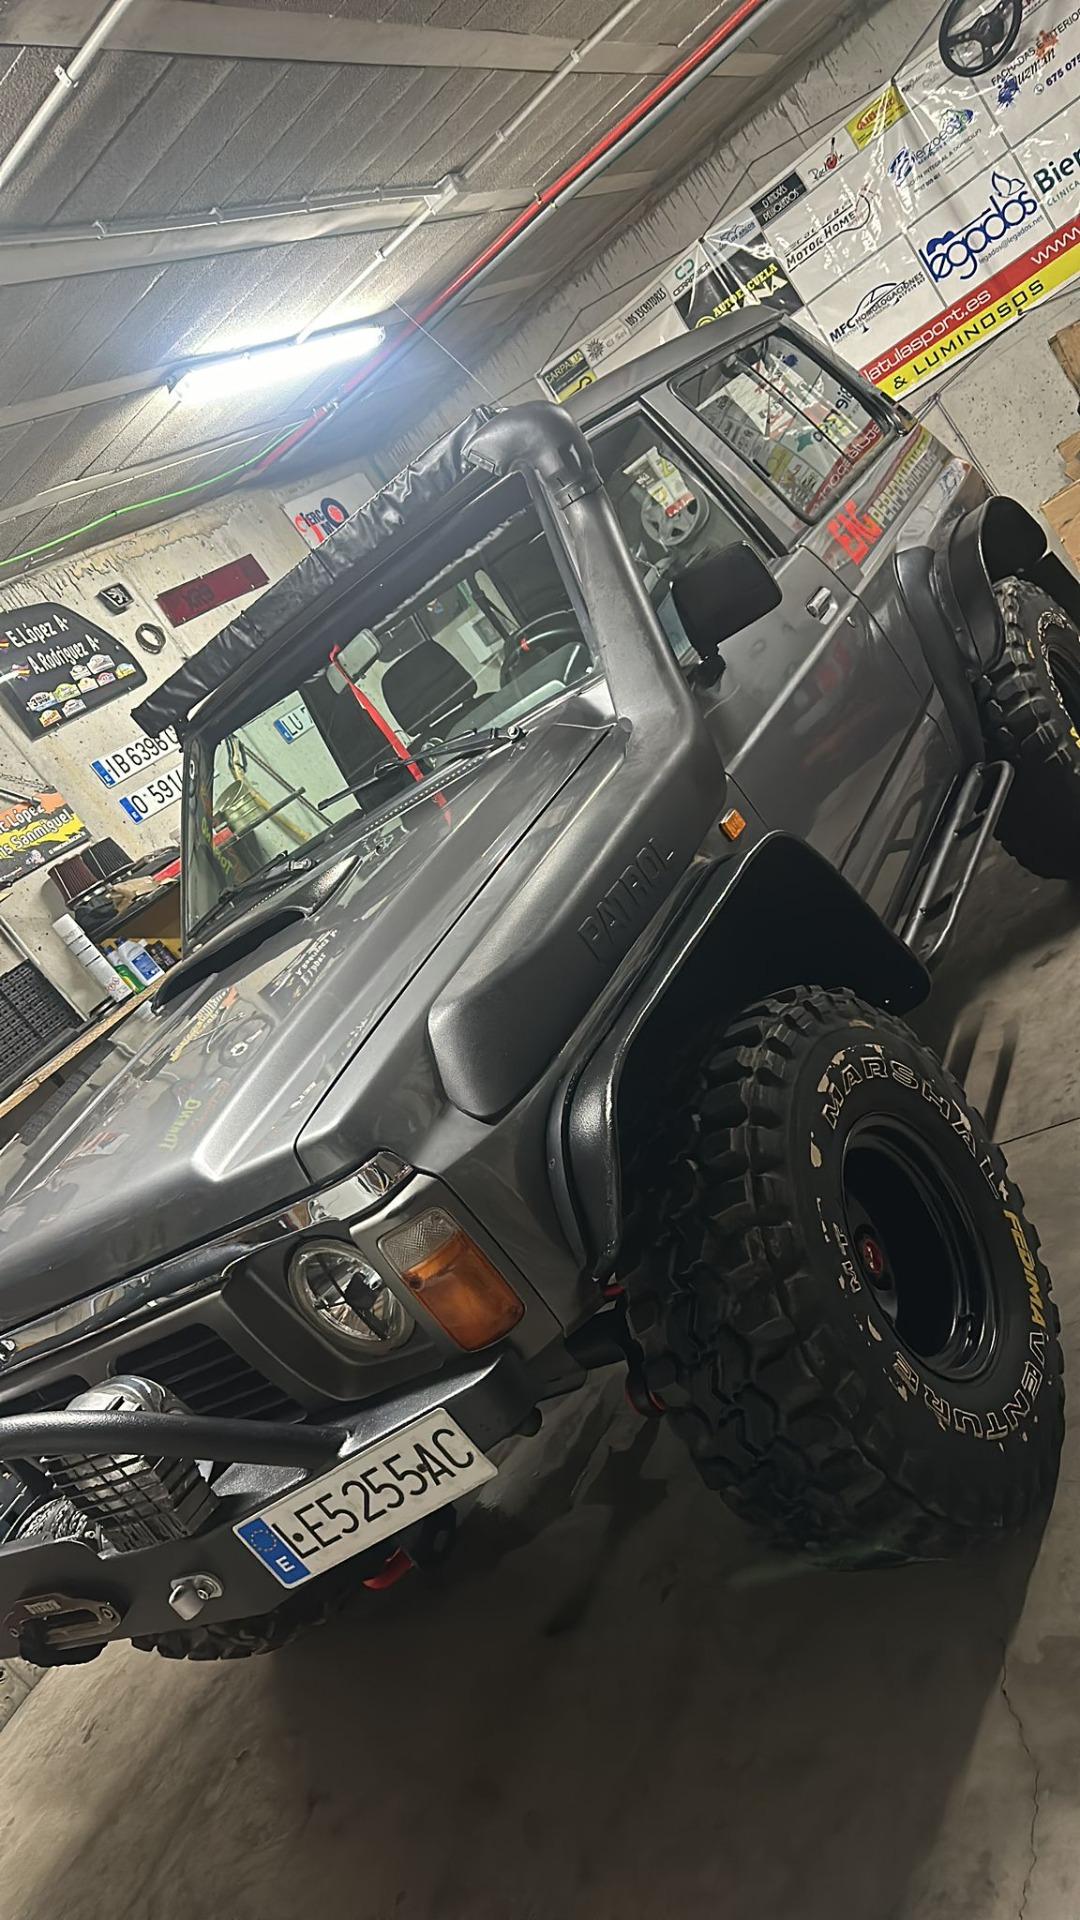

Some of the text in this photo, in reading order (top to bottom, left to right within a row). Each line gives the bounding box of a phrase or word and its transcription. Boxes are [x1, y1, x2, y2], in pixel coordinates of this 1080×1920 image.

[1045, 68, 1064, 87] 675
[786, 235, 825, 269] MOTOR
[823, 210, 857, 240] HOME
[978, 215, 1044, 265] legados@legados.net
[712, 262, 778, 317] AUTOESCUELA
[829, 318, 856, 342] MFC
[855, 271, 924, 325] HOMOLOGACIONES
[863, 289, 991, 382] latulasport.es
[913, 279, 1044, 376] LUMINOSOS
[10, 808, 73, 849] Sanmiguel
[577, 838, 675, 962] PATROL
[1003, 1209, 1046, 1329] FEDIMA
[893, 1331, 1045, 1440] VENTURE
[271, 1428, 474, 1559] LE5255AC
[275, 1555, 295, 1573] E
